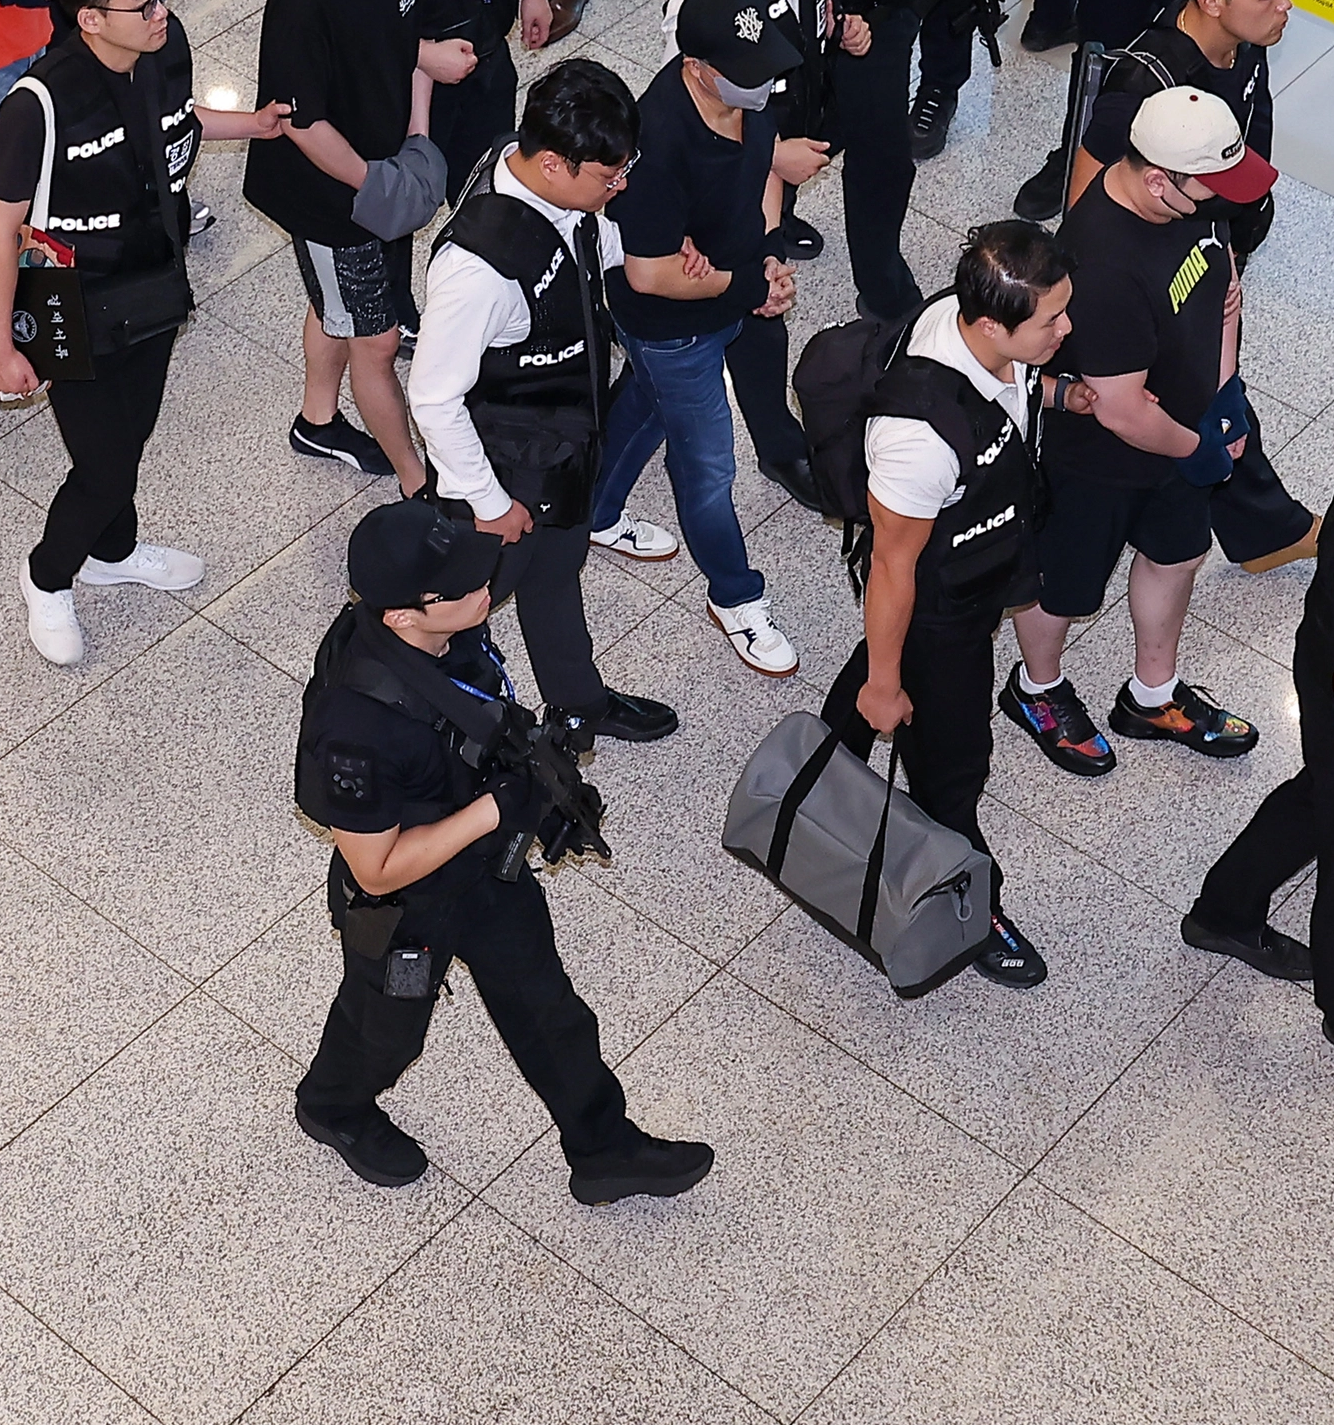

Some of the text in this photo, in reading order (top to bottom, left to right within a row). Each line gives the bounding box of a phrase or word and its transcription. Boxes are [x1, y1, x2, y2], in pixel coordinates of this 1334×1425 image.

[67, 126, 126, 161] POLICE
[48, 213, 121, 232] POLICE
[533, 247, 565, 299] POLICE
[1168, 244, 1209, 315] PUMA
[519, 339, 585, 368] POLICE
[952, 504, 1016, 548] POLICE
